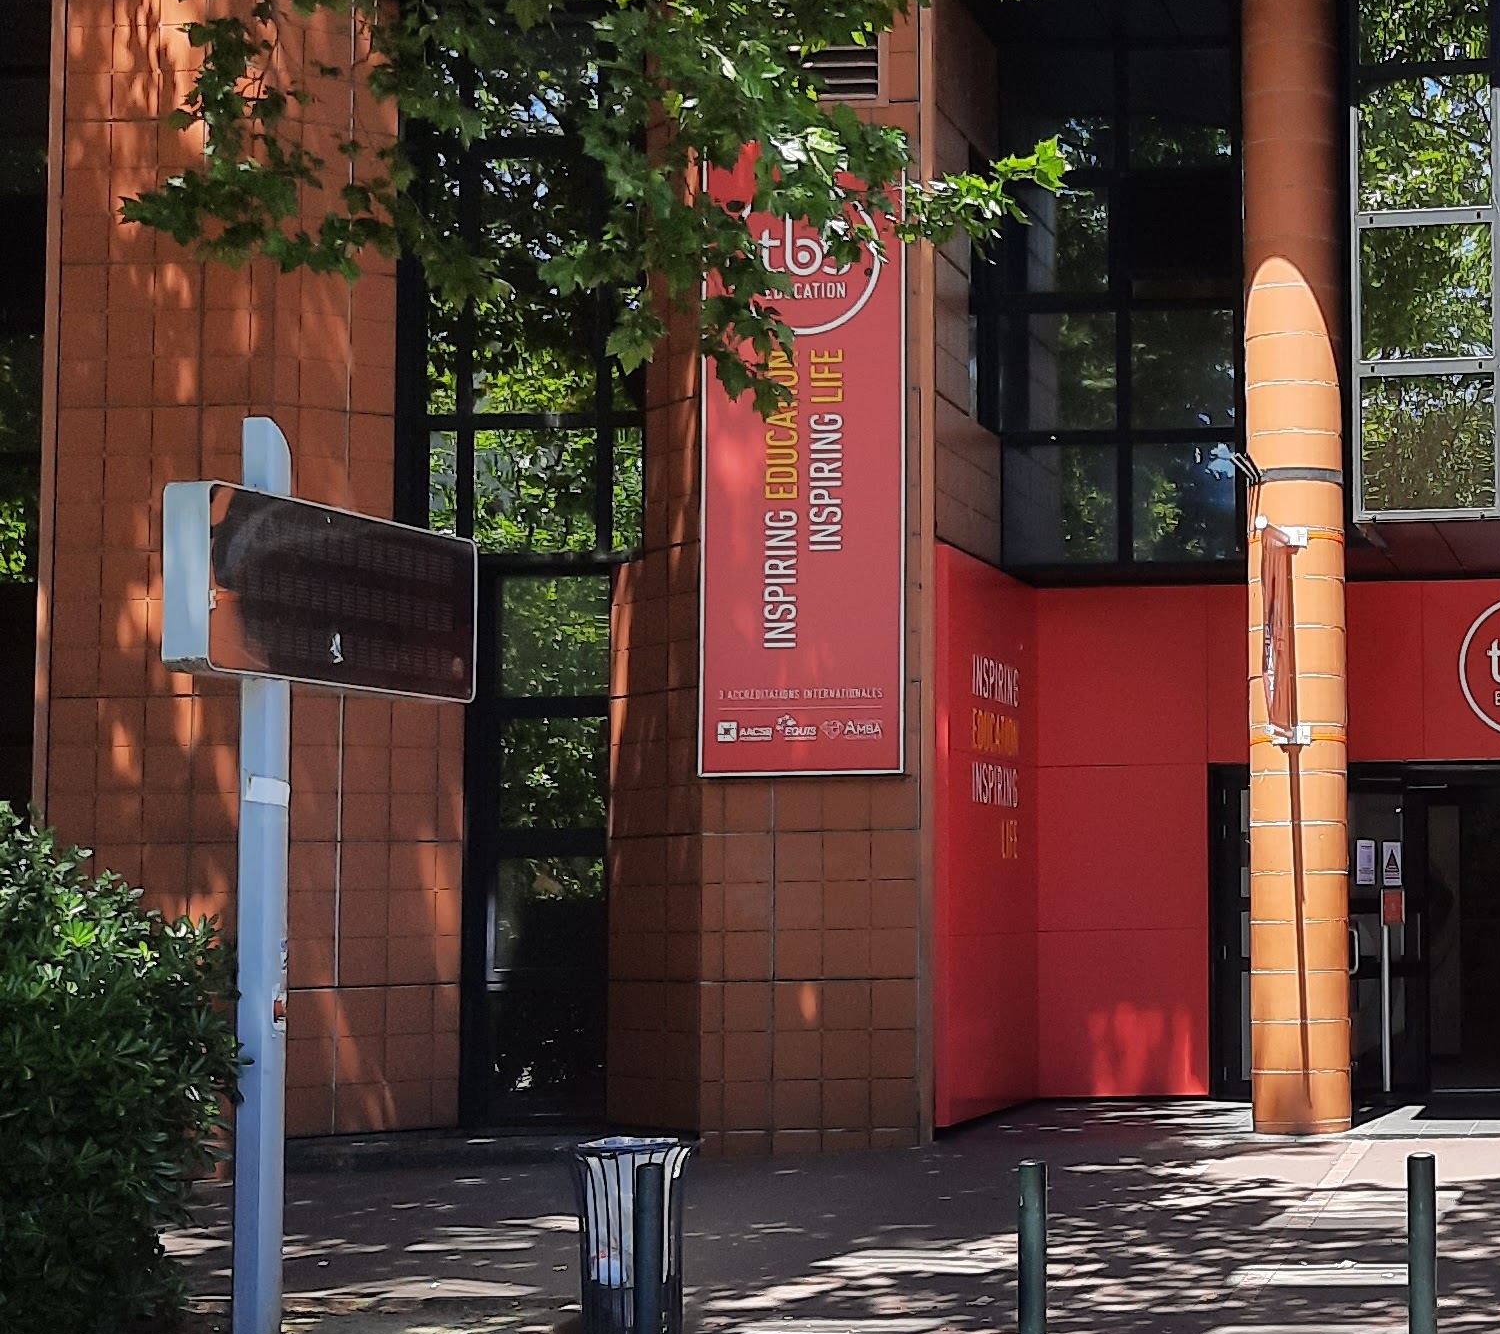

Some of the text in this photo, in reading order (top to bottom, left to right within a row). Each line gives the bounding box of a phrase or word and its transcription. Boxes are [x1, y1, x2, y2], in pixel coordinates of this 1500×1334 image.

[764, 281, 846, 300] EDCATION
[809, 348, 843, 551] INSPIRING LIFE
[763, 349, 799, 648] INSPIRING EDUCAON
[972, 653, 1020, 708] INSPIRING
[971, 761, 1019, 808] INSPIRING
